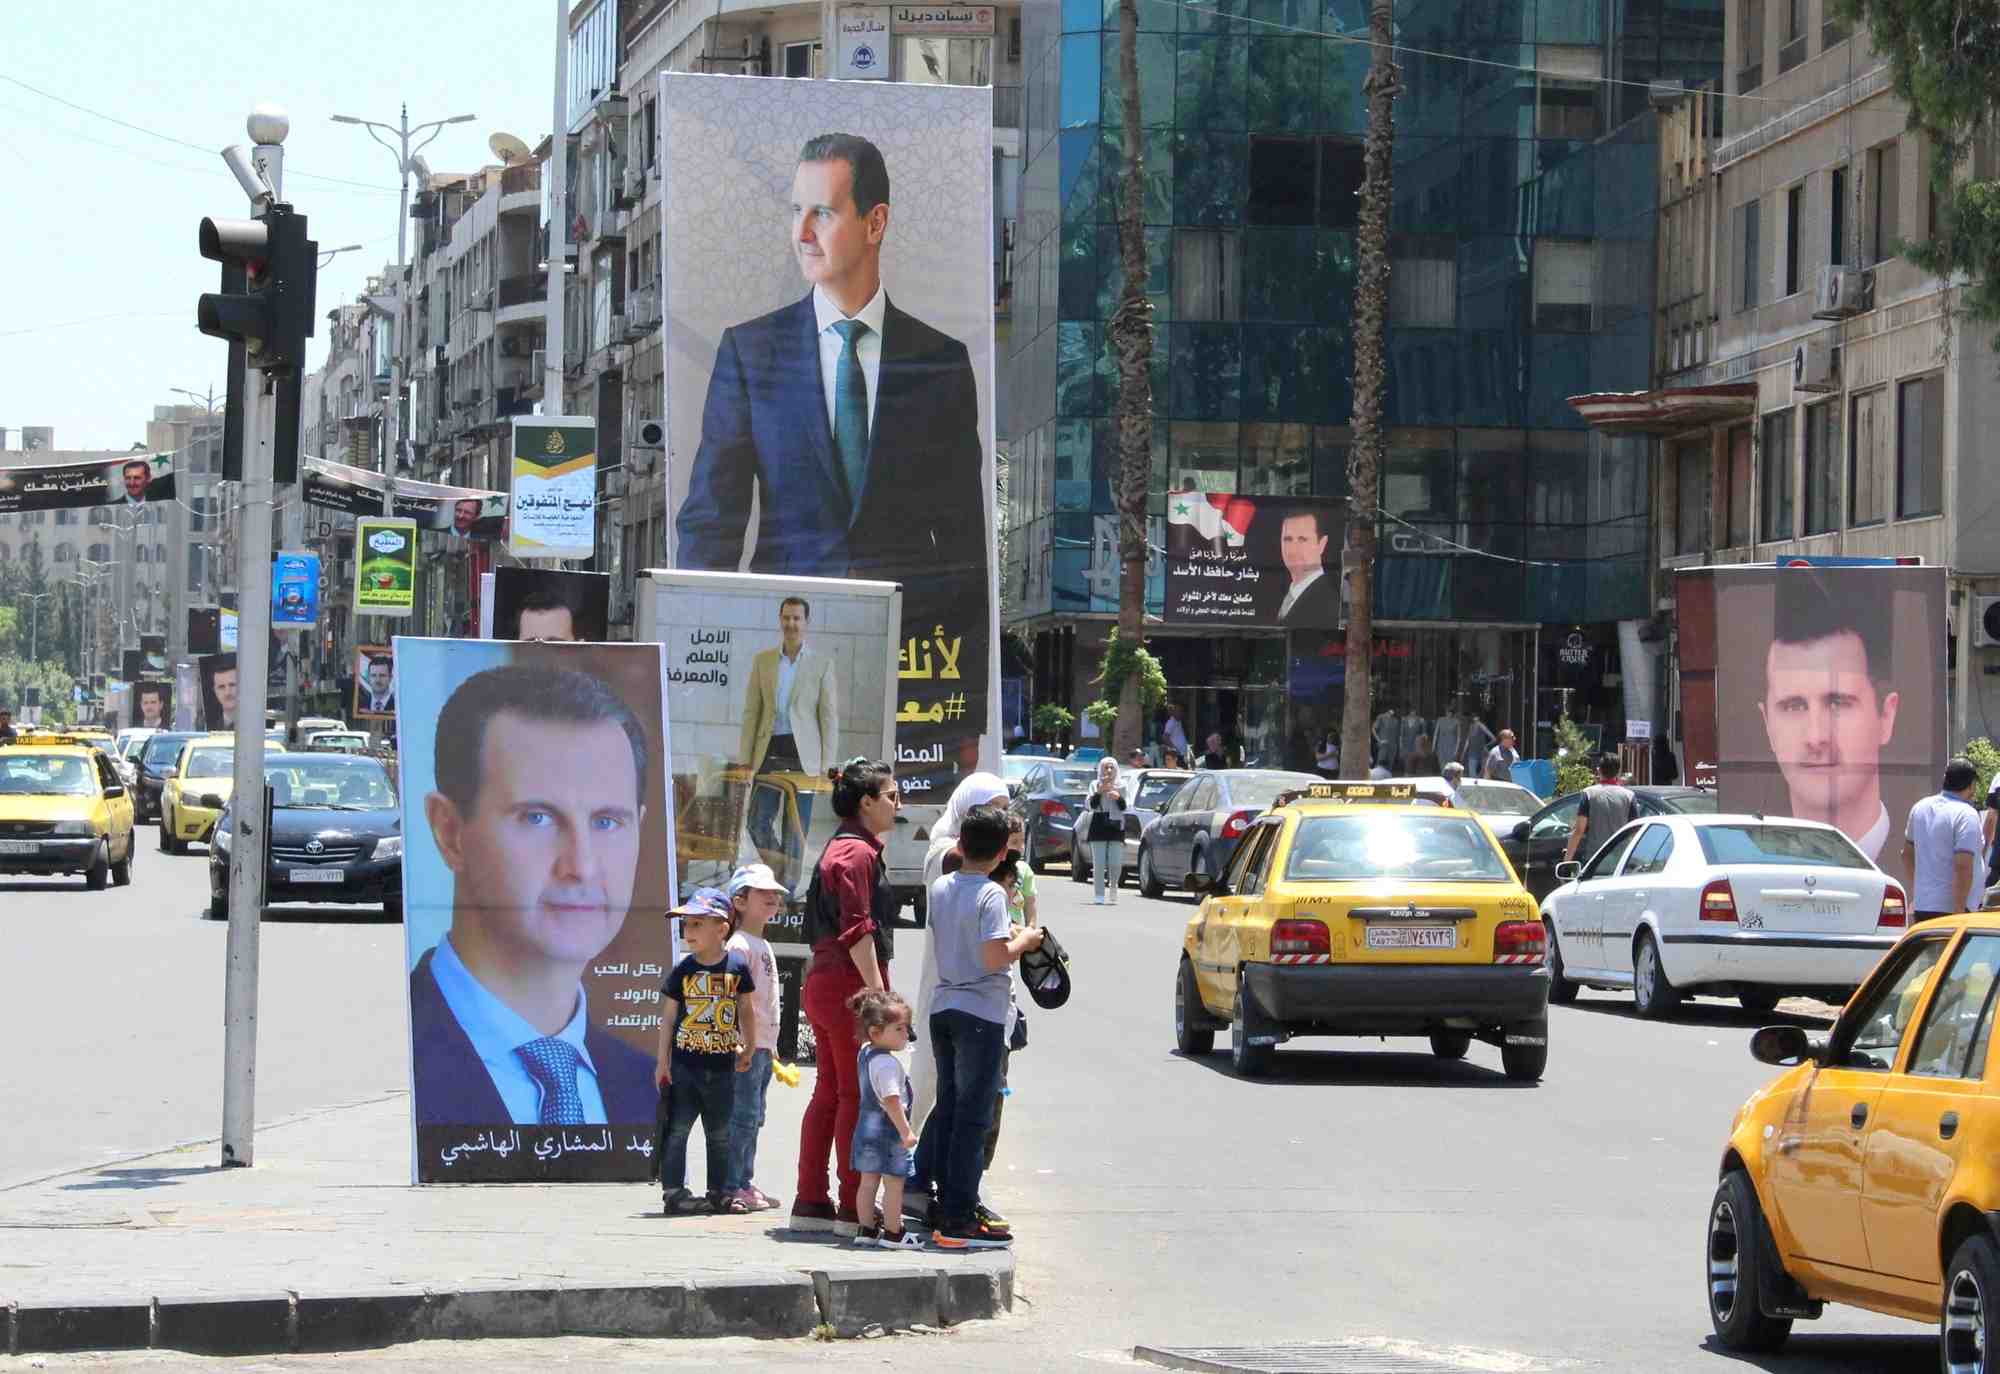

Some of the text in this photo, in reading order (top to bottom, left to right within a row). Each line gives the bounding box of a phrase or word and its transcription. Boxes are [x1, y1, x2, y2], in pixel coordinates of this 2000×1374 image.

[1172, 562, 1260, 582] بشار حافظ الأسد
[686, 650, 729, 667] بالعلم
[902, 776, 931, 794] عضو
[1310, 785, 1332, 798] TAXI
[594, 963, 663, 978] بكل الحب
[614, 988, 660, 1004] والولاء
[681, 998, 738, 1031] ZO
[440, 1129, 655, 1166] هد المشاري الهاشمي
